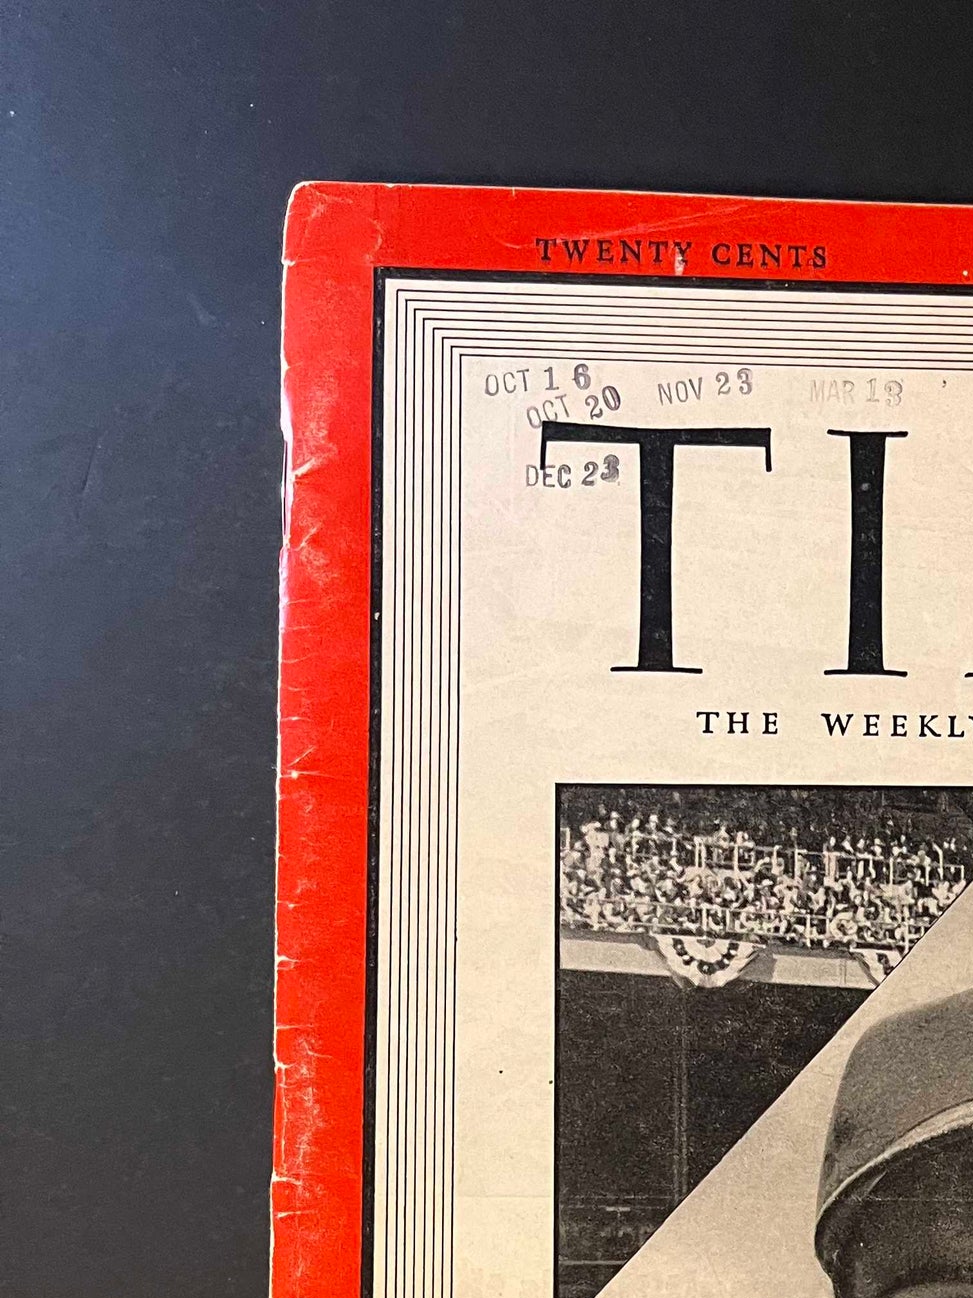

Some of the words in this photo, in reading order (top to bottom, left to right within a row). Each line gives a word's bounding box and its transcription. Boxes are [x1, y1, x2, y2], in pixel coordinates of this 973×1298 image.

[536, 238, 692, 266] TWENTY
[711, 242, 827, 268] CENTS
[485, 368, 530, 397] OCT
[657, 377, 703, 406] NOV
[715, 368, 753, 396] 23
[810, 379, 855, 404] MAR
[526, 394, 570, 429] OCT
[584, 385, 622, 420] 20
[525, 463, 572, 489] DEC
[581, 454, 620, 487] 23
[696, 711, 778, 735] THE
